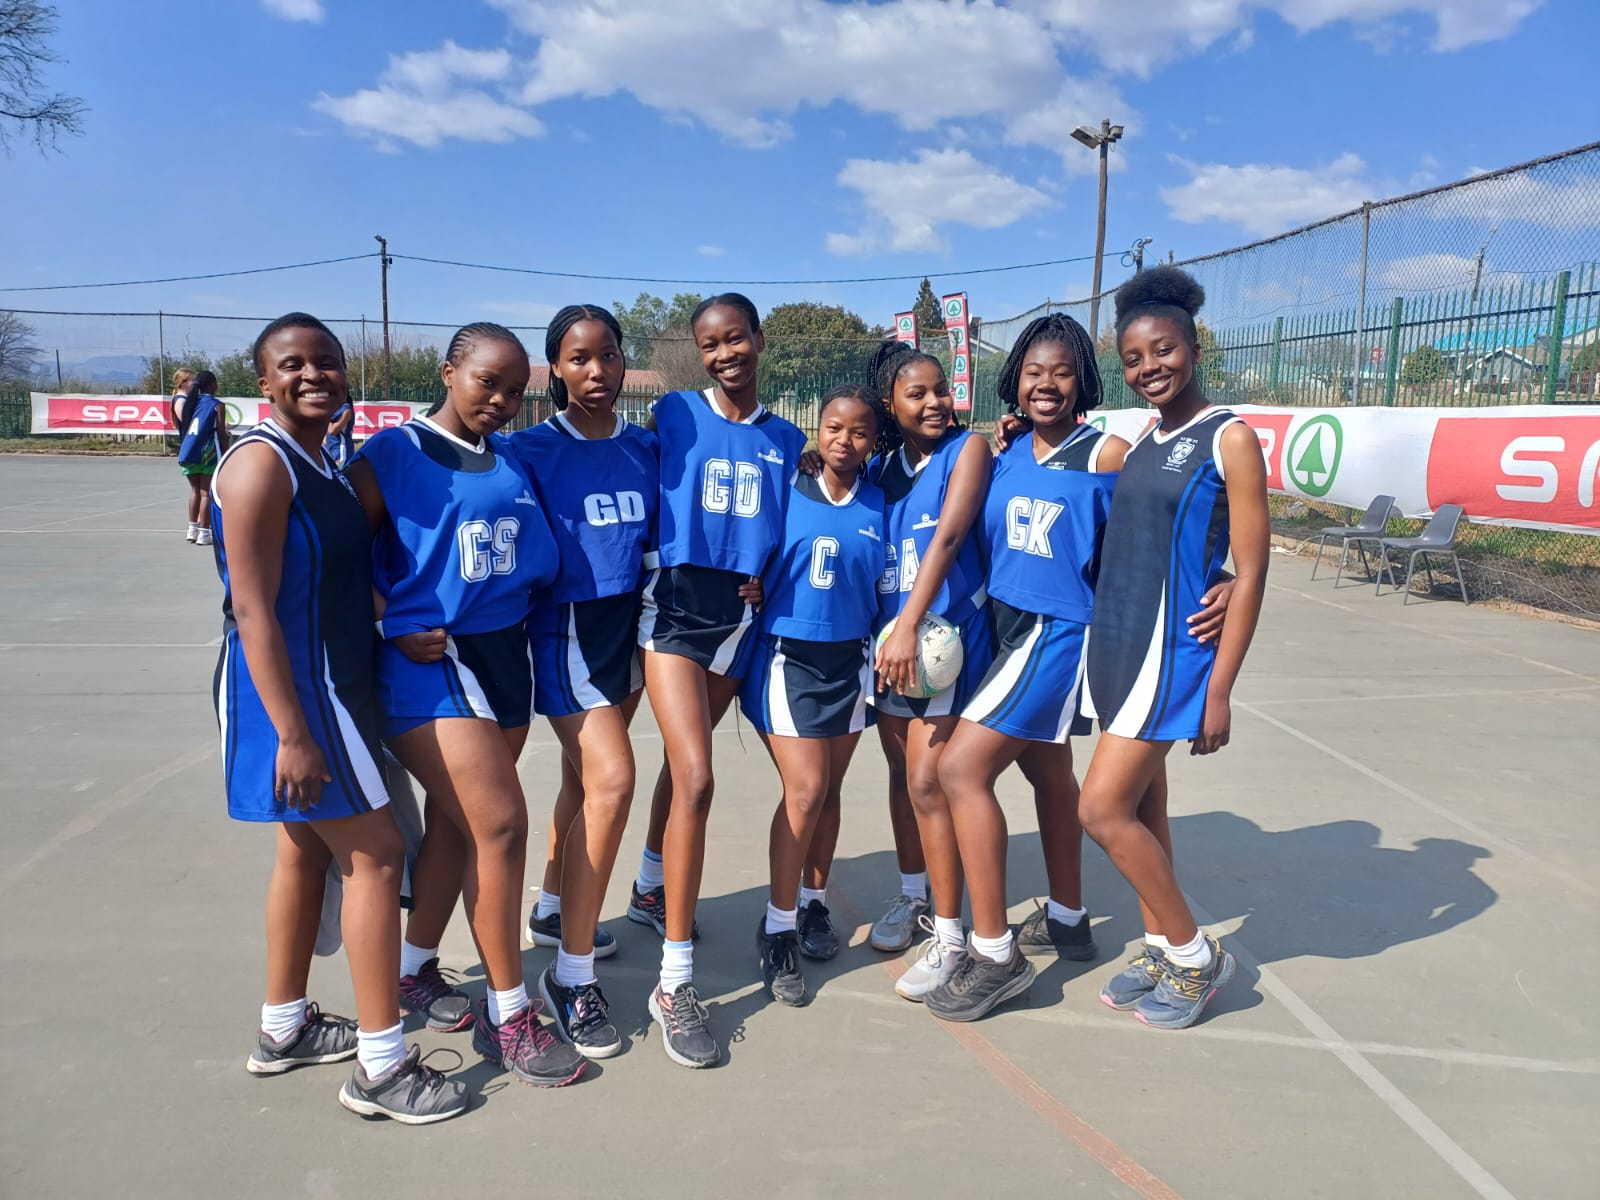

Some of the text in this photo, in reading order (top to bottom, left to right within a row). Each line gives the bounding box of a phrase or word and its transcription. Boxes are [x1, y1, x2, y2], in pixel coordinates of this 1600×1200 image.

[81, 405, 168, 425] SPA
[584, 491, 646, 526] GD
[702, 458, 762, 518] GD
[457, 516, 520, 584] GS
[1006, 496, 1065, 559] GK
[809, 536, 840, 590] C
